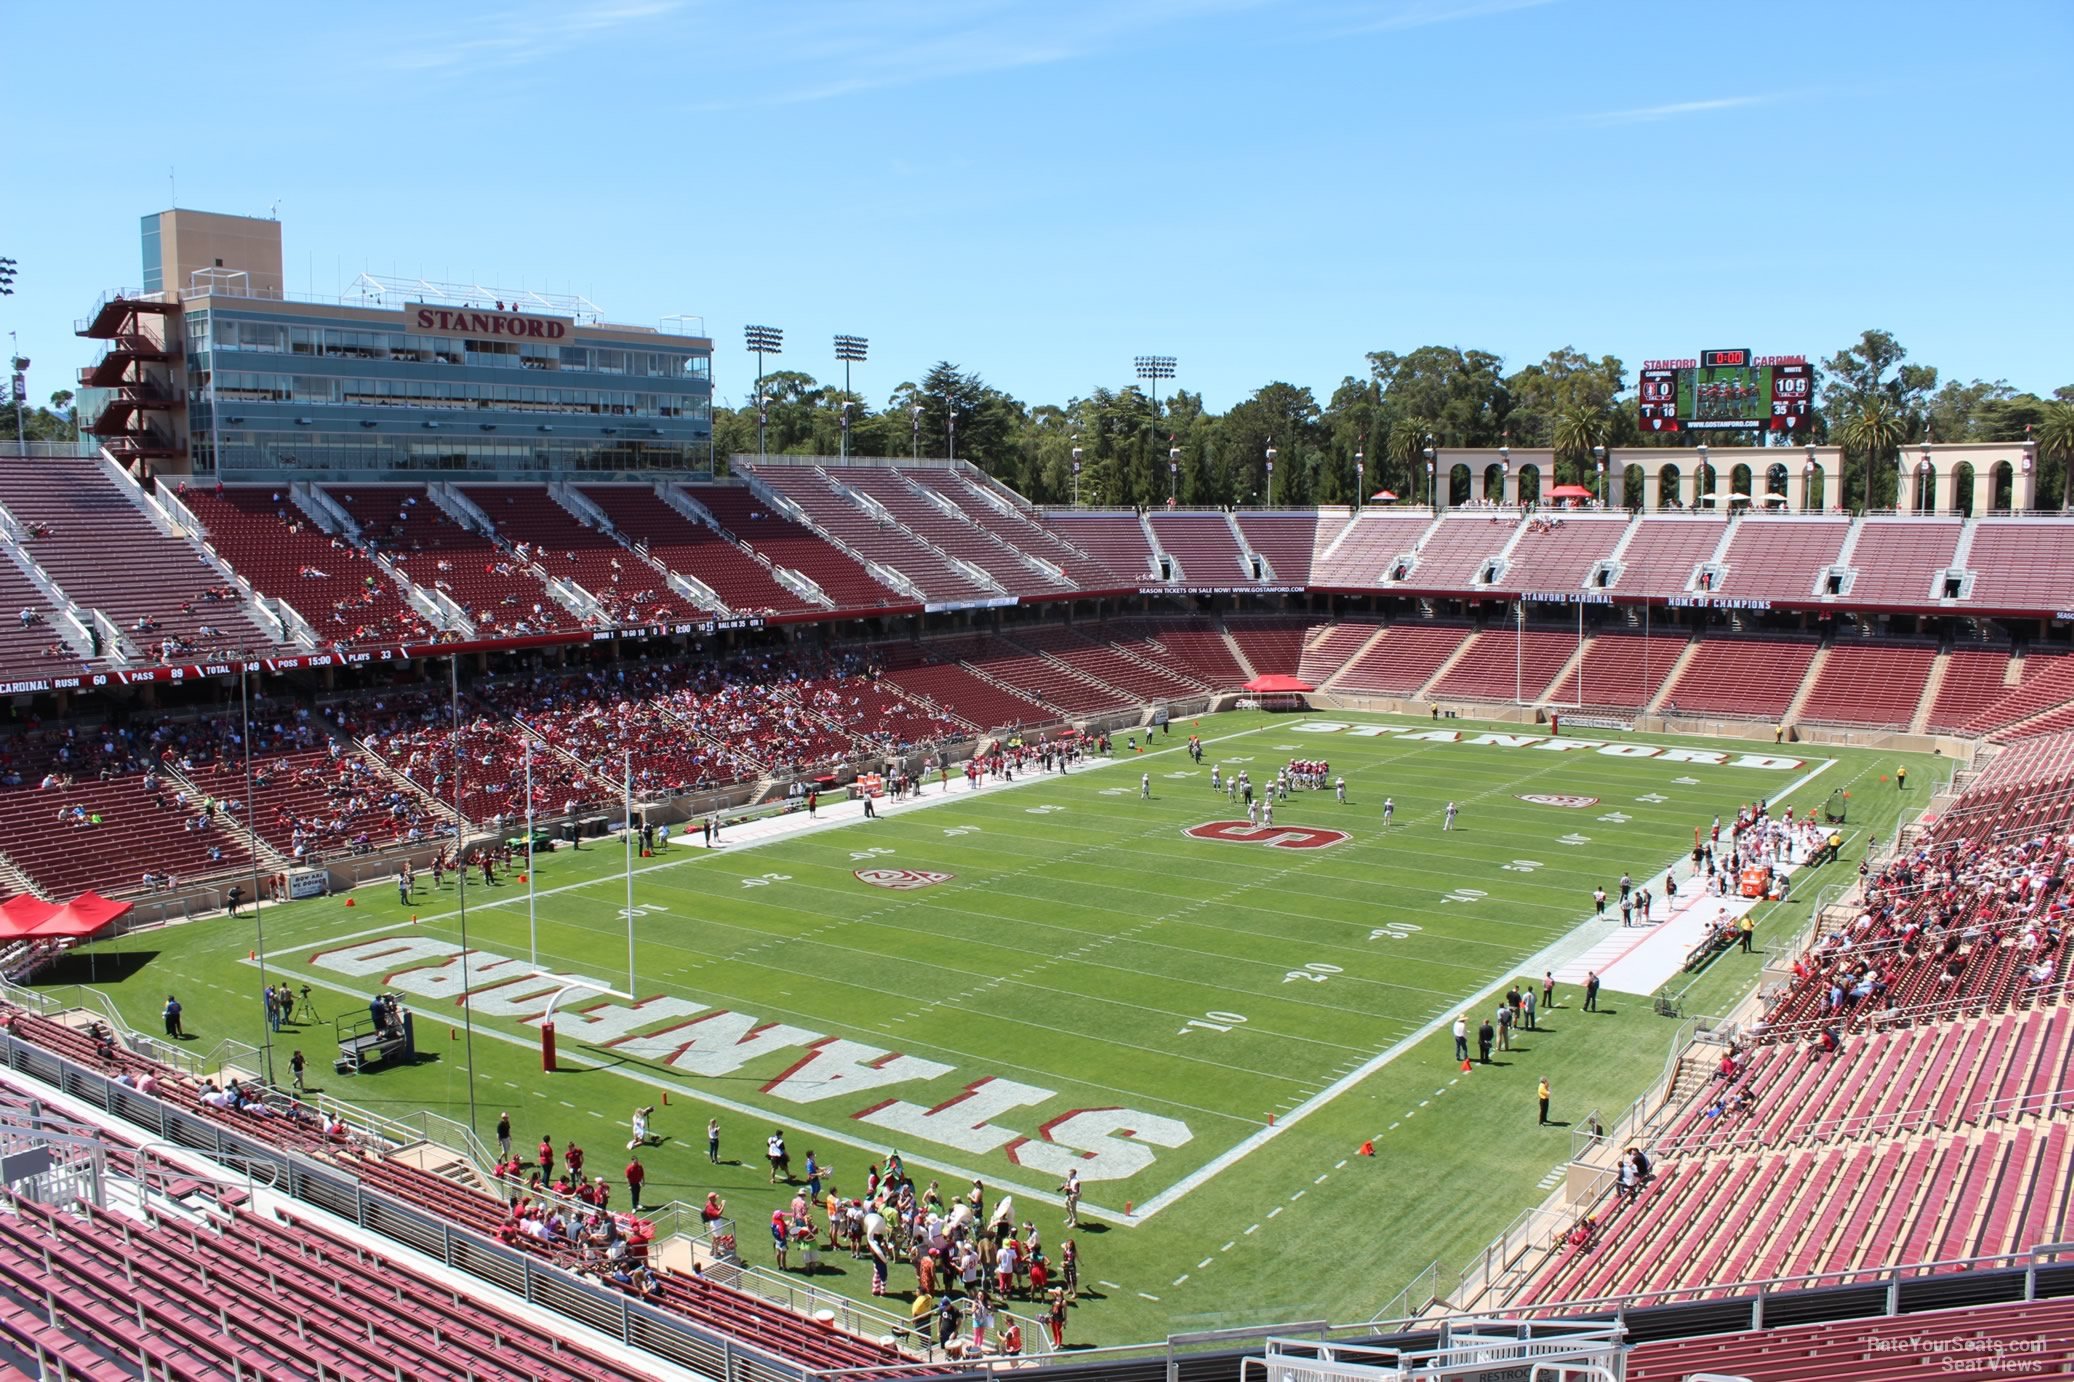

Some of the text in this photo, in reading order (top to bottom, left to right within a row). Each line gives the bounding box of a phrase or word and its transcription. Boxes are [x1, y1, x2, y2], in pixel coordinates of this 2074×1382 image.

[418, 309, 565, 339] STANFORD
[1716, 352, 1742, 364] 0:00
[1643, 359, 1697, 370] STANFORD
[1521, 592, 1614, 604] STANFORD CARDINAL
[1668, 597, 1771, 609] HOME OF CHAMPIONS
[349, 650, 391, 661] PLAYS 33
[278, 656, 331, 668] POSS 15:00
[131, 668, 183, 681] PASS 89
[206, 665, 231, 675] TOTAL
[0, 681, 49, 693] CARDINAL
[55, 674, 107, 688] RUSH 60
[1290, 724, 1807, 769] STANFORD
[1187, 1011, 1248, 1033] 10
[308, 935, 1194, 1182] STANFORD
